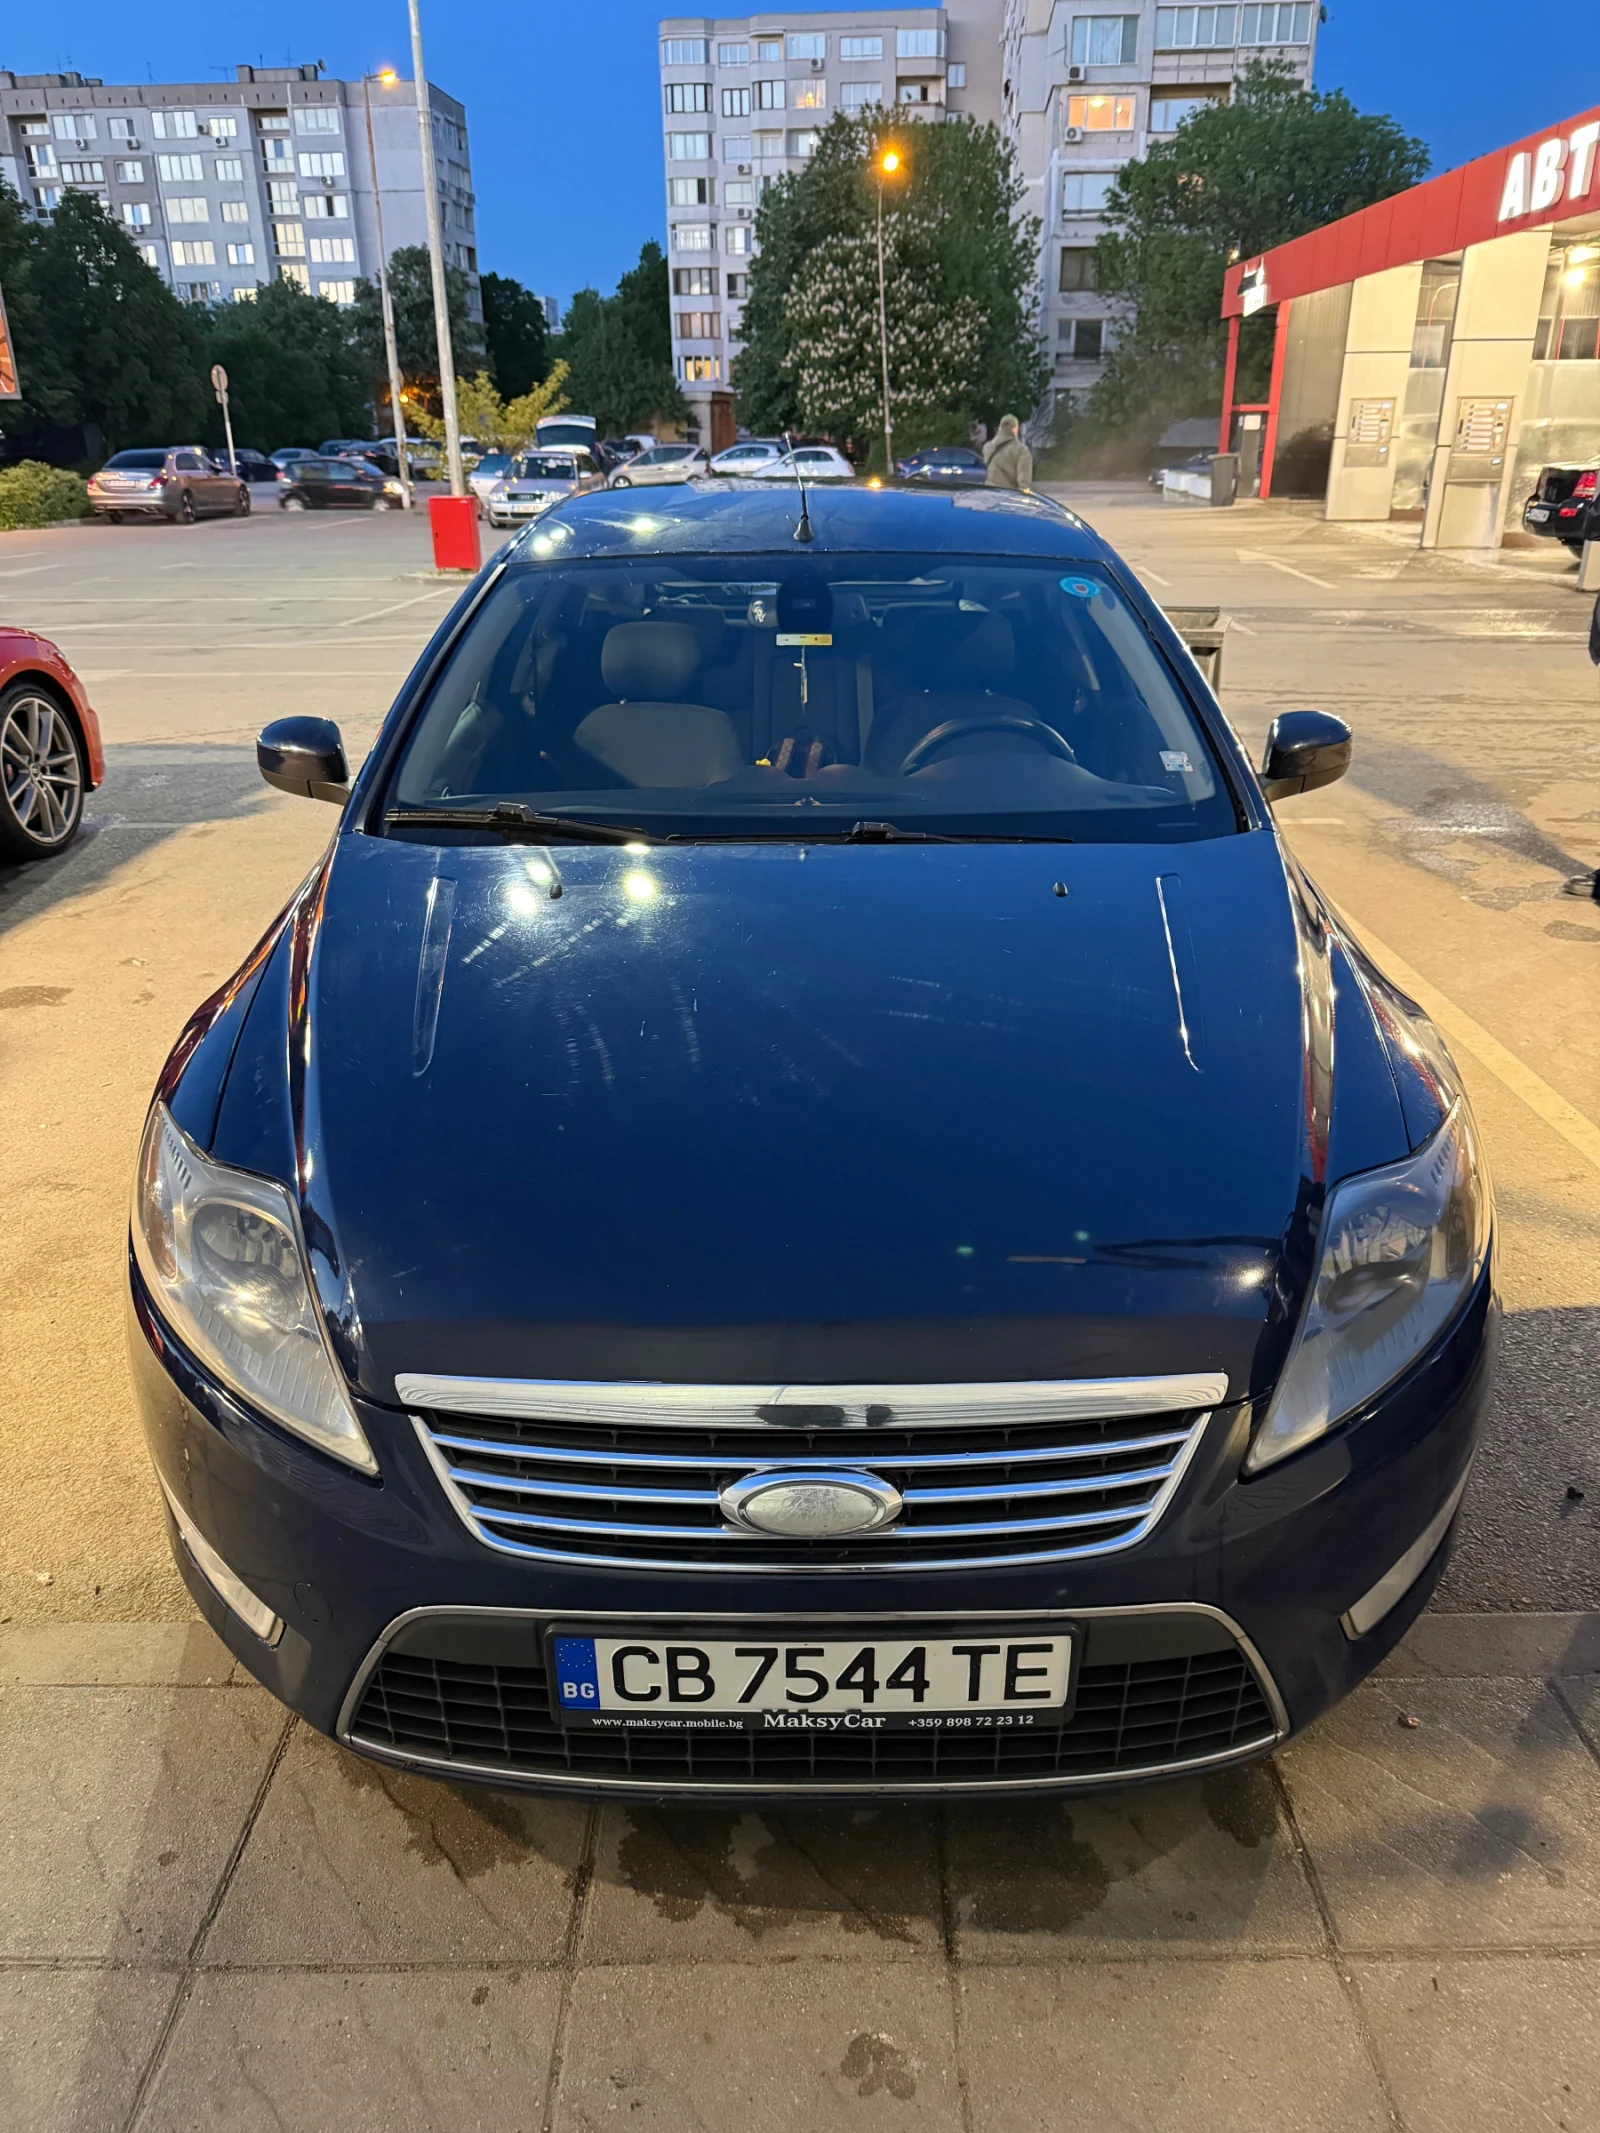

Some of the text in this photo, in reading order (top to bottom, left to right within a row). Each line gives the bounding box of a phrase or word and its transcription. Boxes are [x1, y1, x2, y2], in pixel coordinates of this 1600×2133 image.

[611, 1643, 1054, 1703] CB 7544 TE
[563, 1682, 595, 1698] BG
[592, 1717, 744, 1729] www.maksycar.mobile.bg
[763, 1713, 887, 1730] MaksyCar
[908, 1715, 1034, 1728] +359 898 72 23 12
